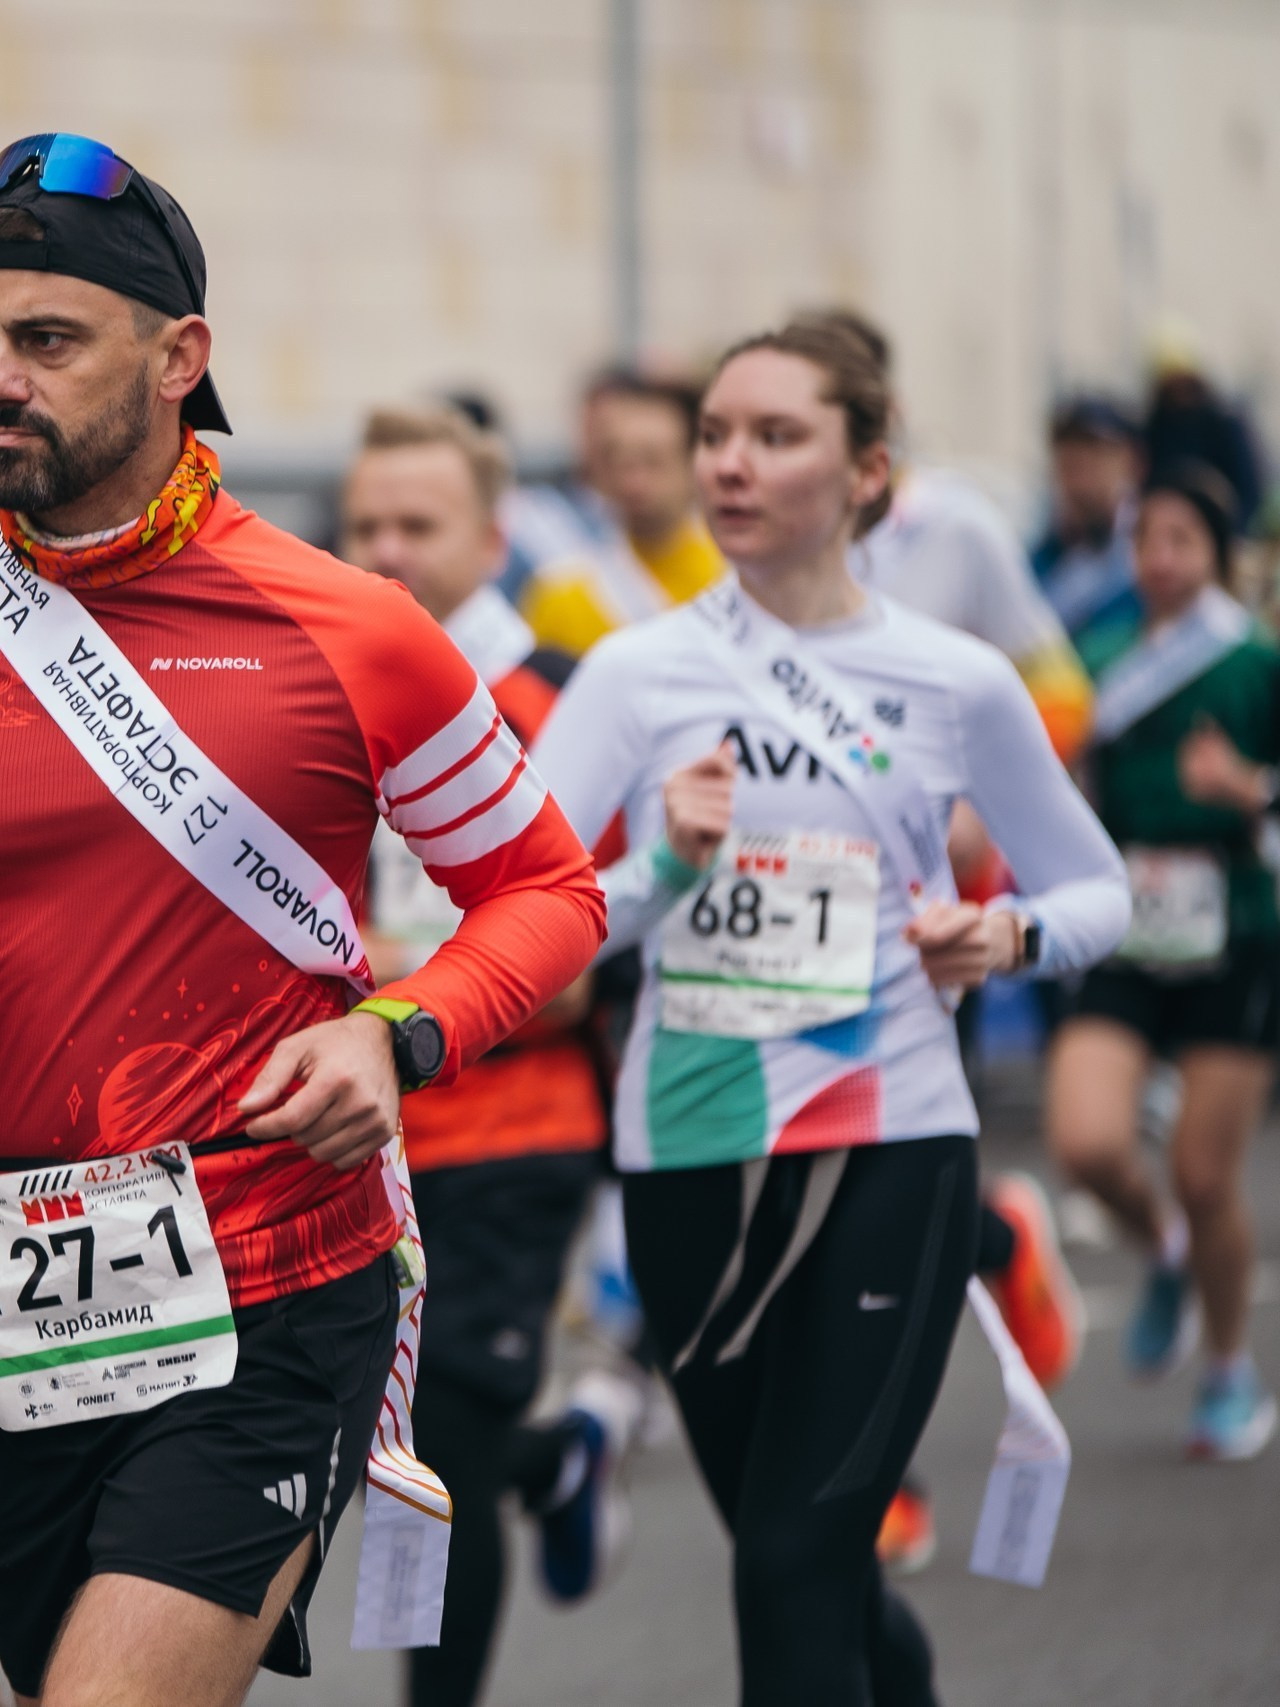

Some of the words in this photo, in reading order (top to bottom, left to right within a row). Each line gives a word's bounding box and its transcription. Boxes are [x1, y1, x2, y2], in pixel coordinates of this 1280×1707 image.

[176, 657, 264, 671] NOVAROLL
[42, 660, 173, 815] КОРПОРАТИВНАЯ
[67, 635, 199, 796] ЭСТАФЕТА
[182, 796, 229, 846] 127
[232, 839, 355, 966] NOVAROLL
[689, 878, 833, 946] 68-1
[84, 1158, 136, 1184] 42,2
[35, 1304, 154, 1340] Карбамид
[77, 1391, 116, 1407] FONBET
